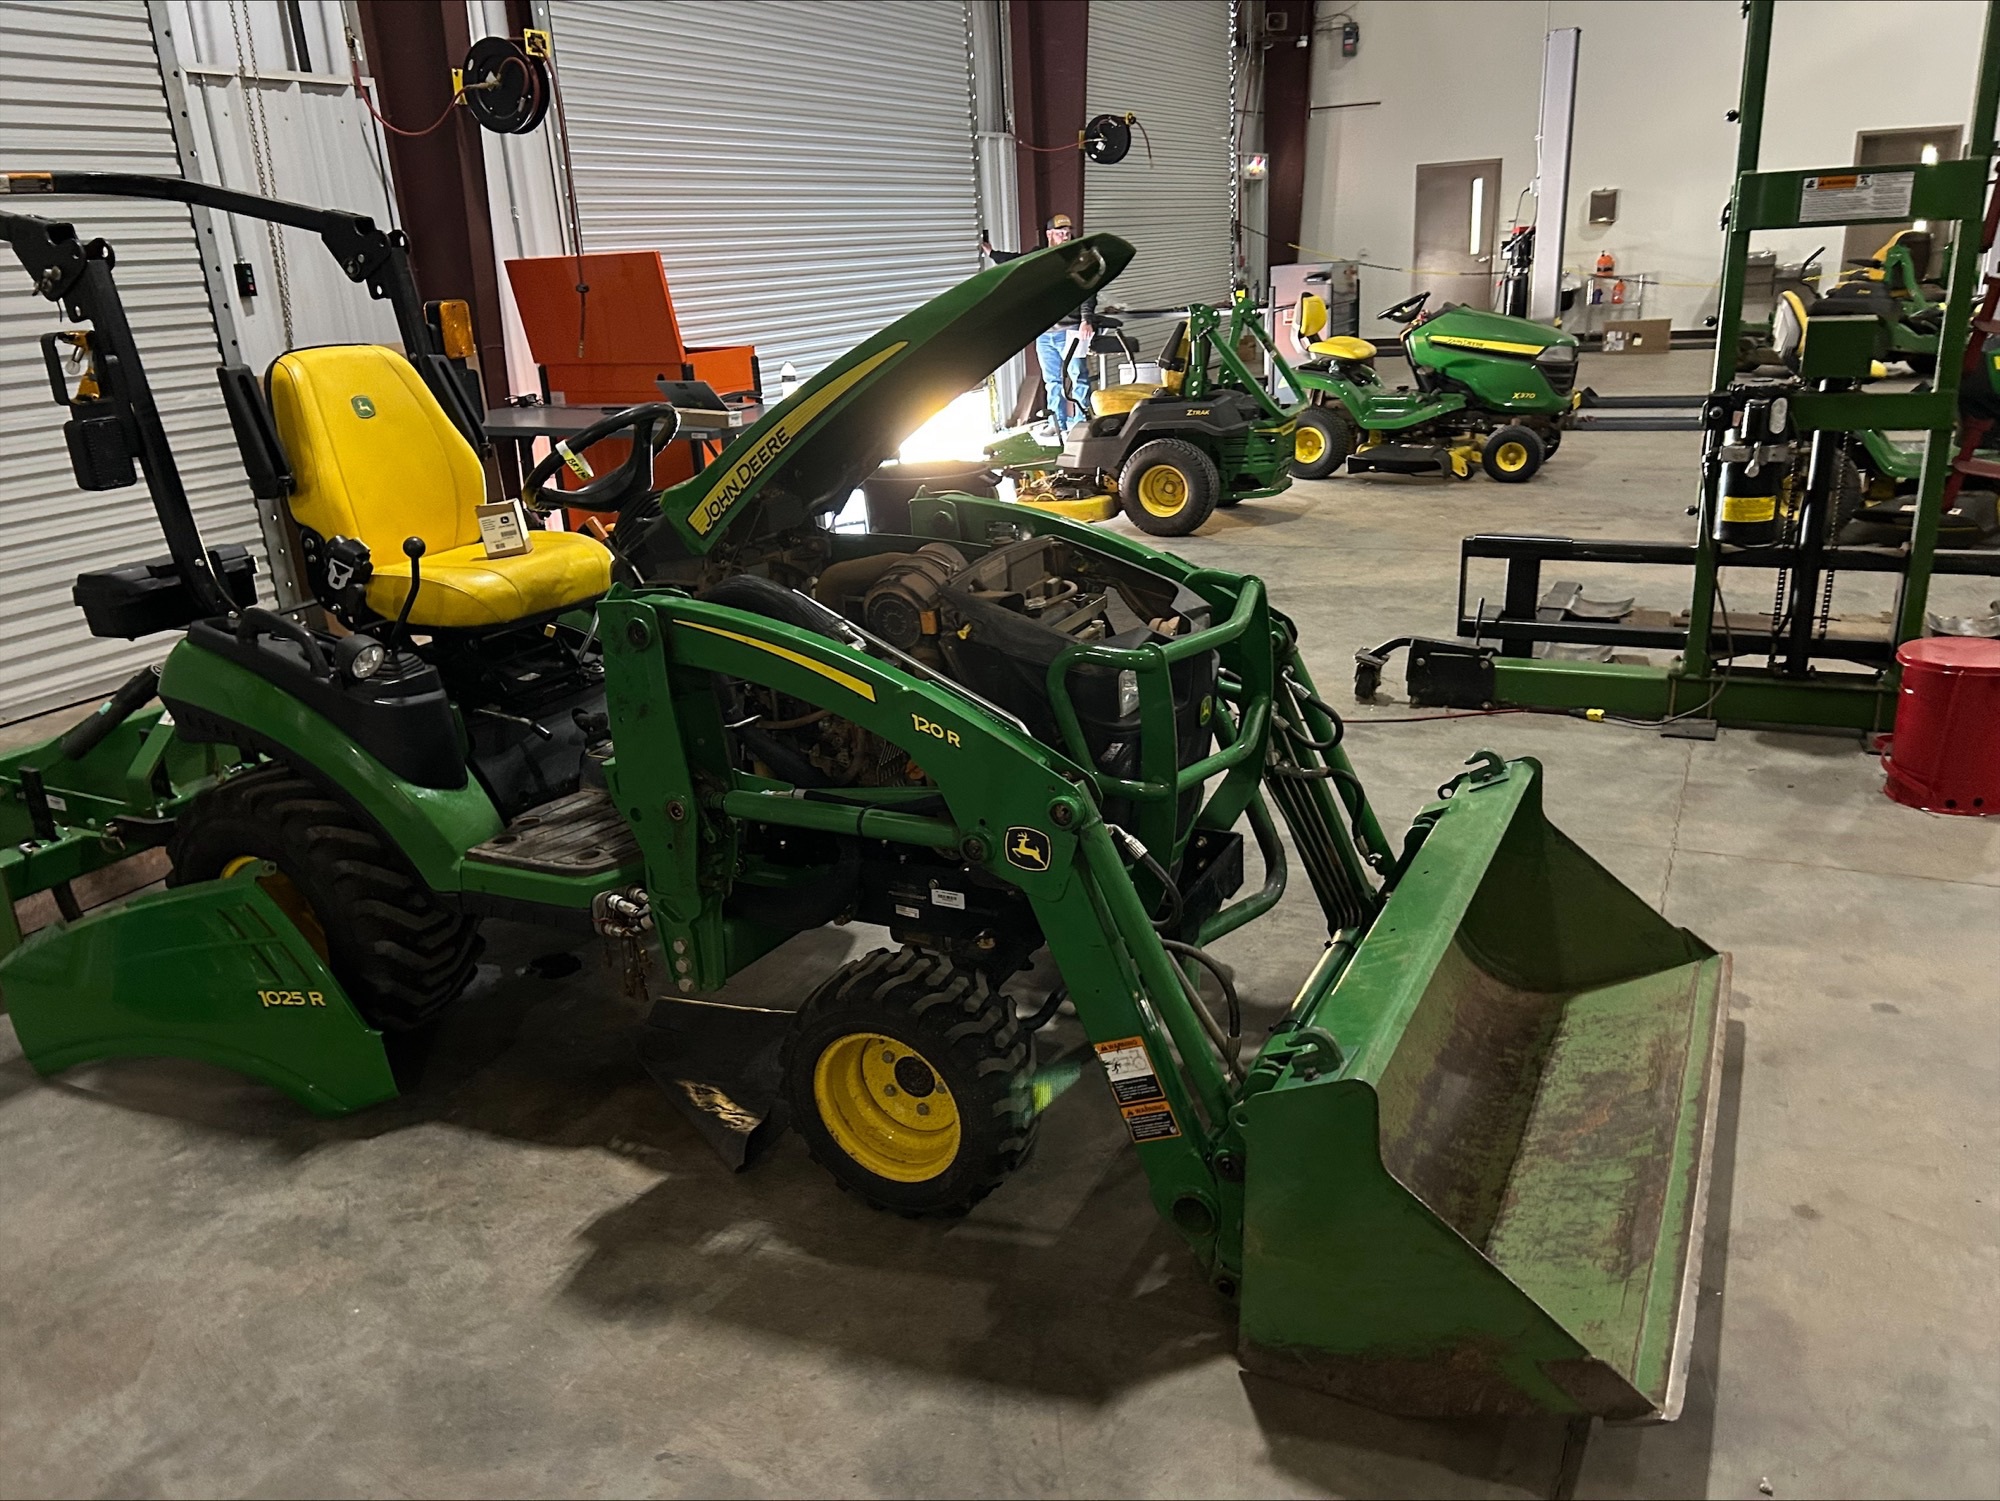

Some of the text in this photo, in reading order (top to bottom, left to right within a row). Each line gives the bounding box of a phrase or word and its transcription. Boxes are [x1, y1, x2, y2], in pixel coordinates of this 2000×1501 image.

[1511, 392, 1536, 400] X370
[704, 426, 792, 528] JOHN DEERE
[911, 713, 961, 748] 120 R
[257, 990, 327, 1008] 1025 R
